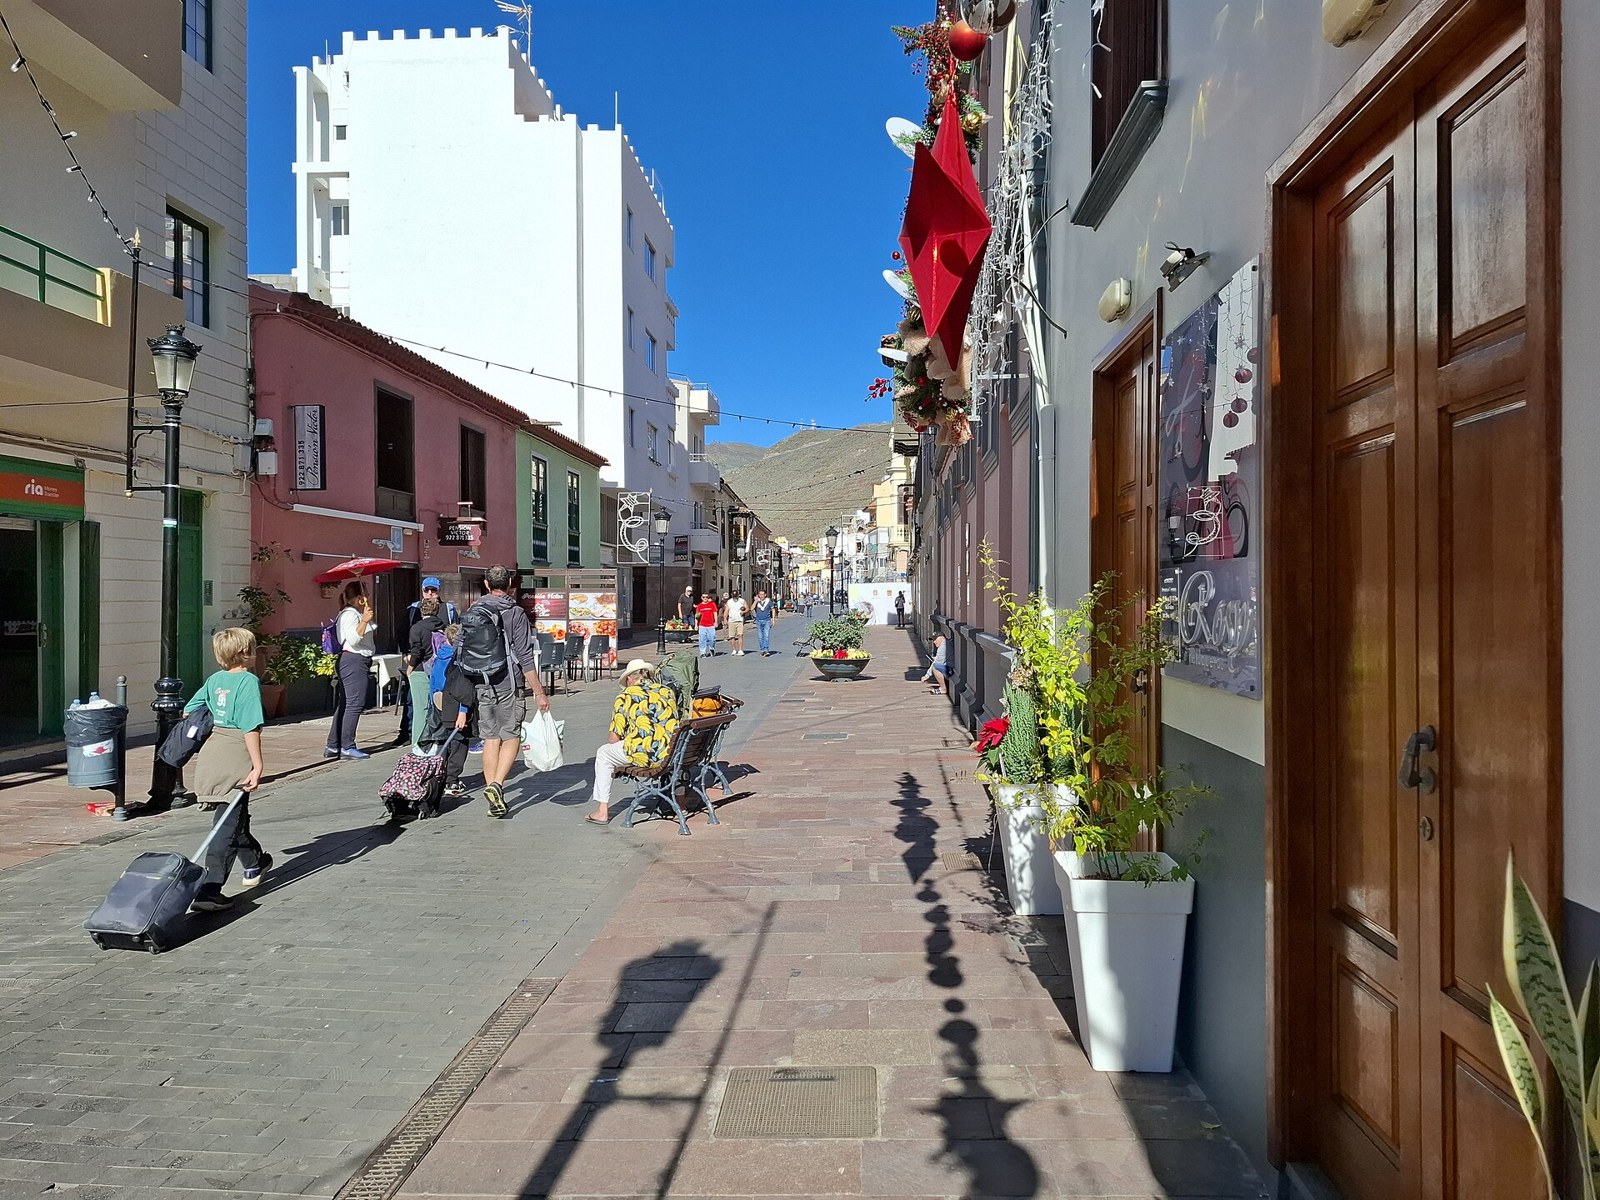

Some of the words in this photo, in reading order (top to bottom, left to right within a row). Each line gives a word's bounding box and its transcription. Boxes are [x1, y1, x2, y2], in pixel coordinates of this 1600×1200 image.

[307, 409, 319, 435] Victor
[305, 440, 319, 486] Pensión
[25, 479, 43, 496] ria
[298, 472, 306, 486] 922
